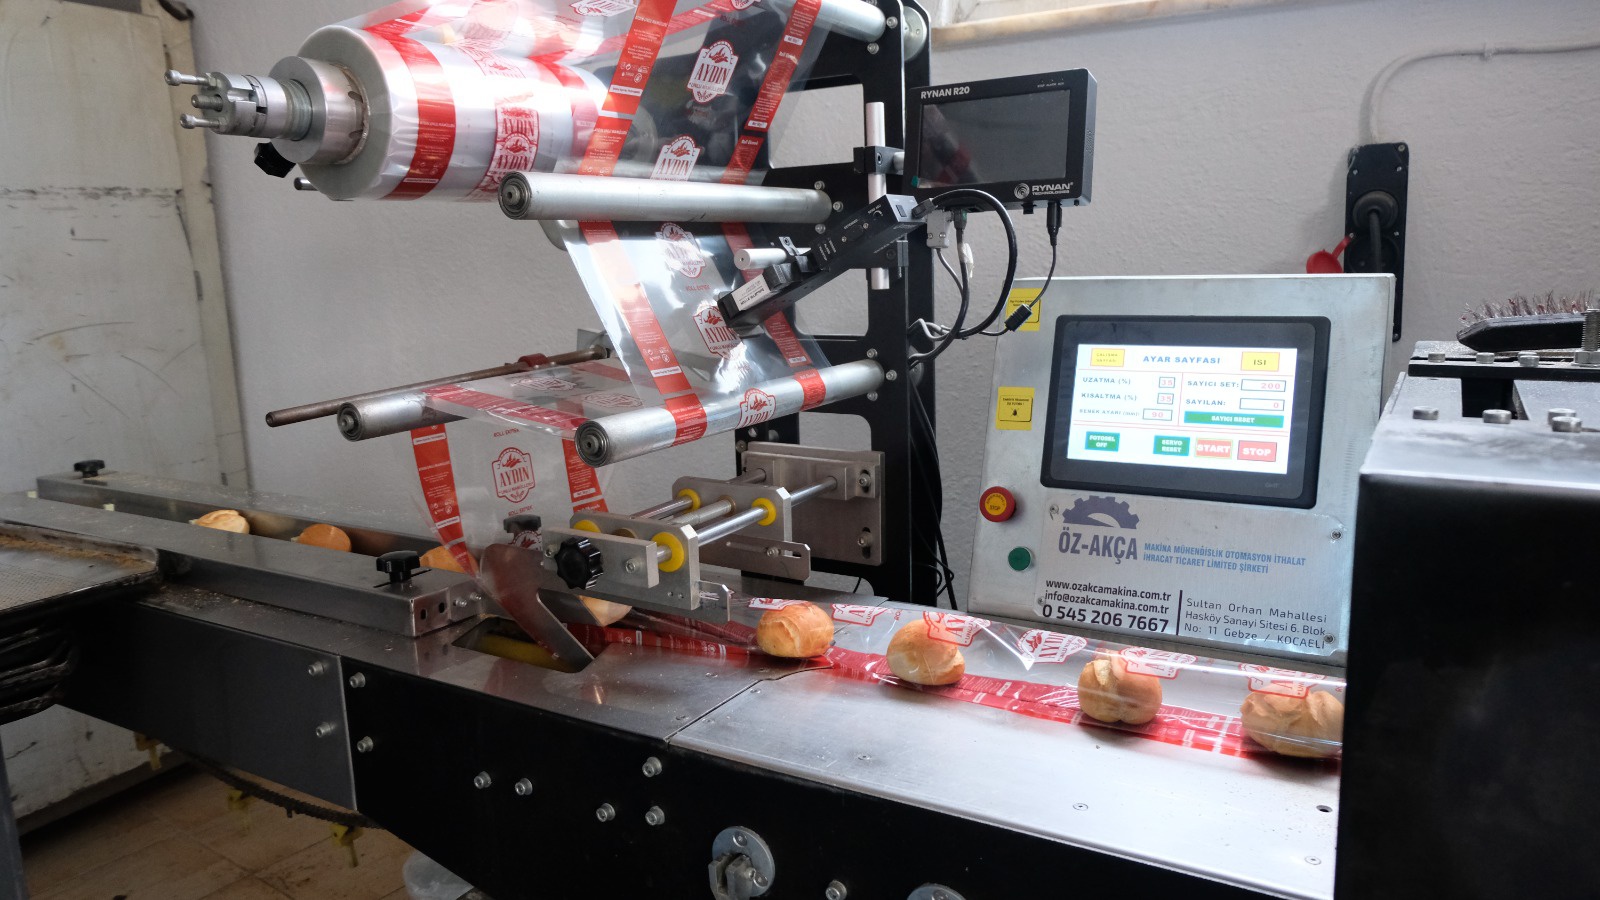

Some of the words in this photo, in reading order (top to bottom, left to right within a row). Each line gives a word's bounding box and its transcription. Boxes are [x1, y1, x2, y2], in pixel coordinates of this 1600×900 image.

[694, 63, 731, 85] AYDIN
[921, 88, 951, 99] RYNAN
[953, 86, 970, 96] R20
[656, 158, 693, 176] AYDIN
[1032, 183, 1071, 192] RYNAN
[1143, 355, 1171, 363] AYAR
[1261, 382, 1281, 390] 200
[1081, 392, 1121, 400] KISALTMA
[1185, 398, 1226, 406] SAYILAN:
[1196, 444, 1231, 454] START
[1242, 447, 1271, 457] STOP
[500, 466, 530, 487] AYDIN
[1058, 526, 1138, 565] ÖZ-AKÇA
[1144, 542, 1172, 553] MAKİNA
[1225, 550, 1272, 563] OTOMASYON
[1274, 553, 1307, 566] İTHALAT
[1175, 555, 1205, 567] TİCARET
[1207, 558, 1237, 571] LİMİTED
[1239, 563, 1269, 574] ŞİRKETİ
[1045, 580, 1172, 601] www.ozakcamakina.com.tr
[1044, 590, 1169, 614] info@ozakcamakina.com.tr
[1186, 598, 1222, 610] Sultan
[1228, 603, 1262, 615] Orhan
[1269, 608, 1327, 623] Mahallesi
[1042, 604, 1053, 618] 0
[1056, 606, 1087, 622] 545
[1090, 610, 1123, 627] 206
[1127, 614, 1169, 633] 7667
[1185, 611, 1222, 624] Hasköy
[1223, 615, 1257, 628] Sanayi
[1259, 619, 1288, 632] Sitesi
[1290, 623, 1300, 633] 6.
[1302, 625, 1326, 636] Blok
[1184, 623, 1202, 633] No:
[1208, 626, 1217, 635] 11
[1224, 627, 1257, 641] Gebze
[1264, 634, 1270, 643] /
